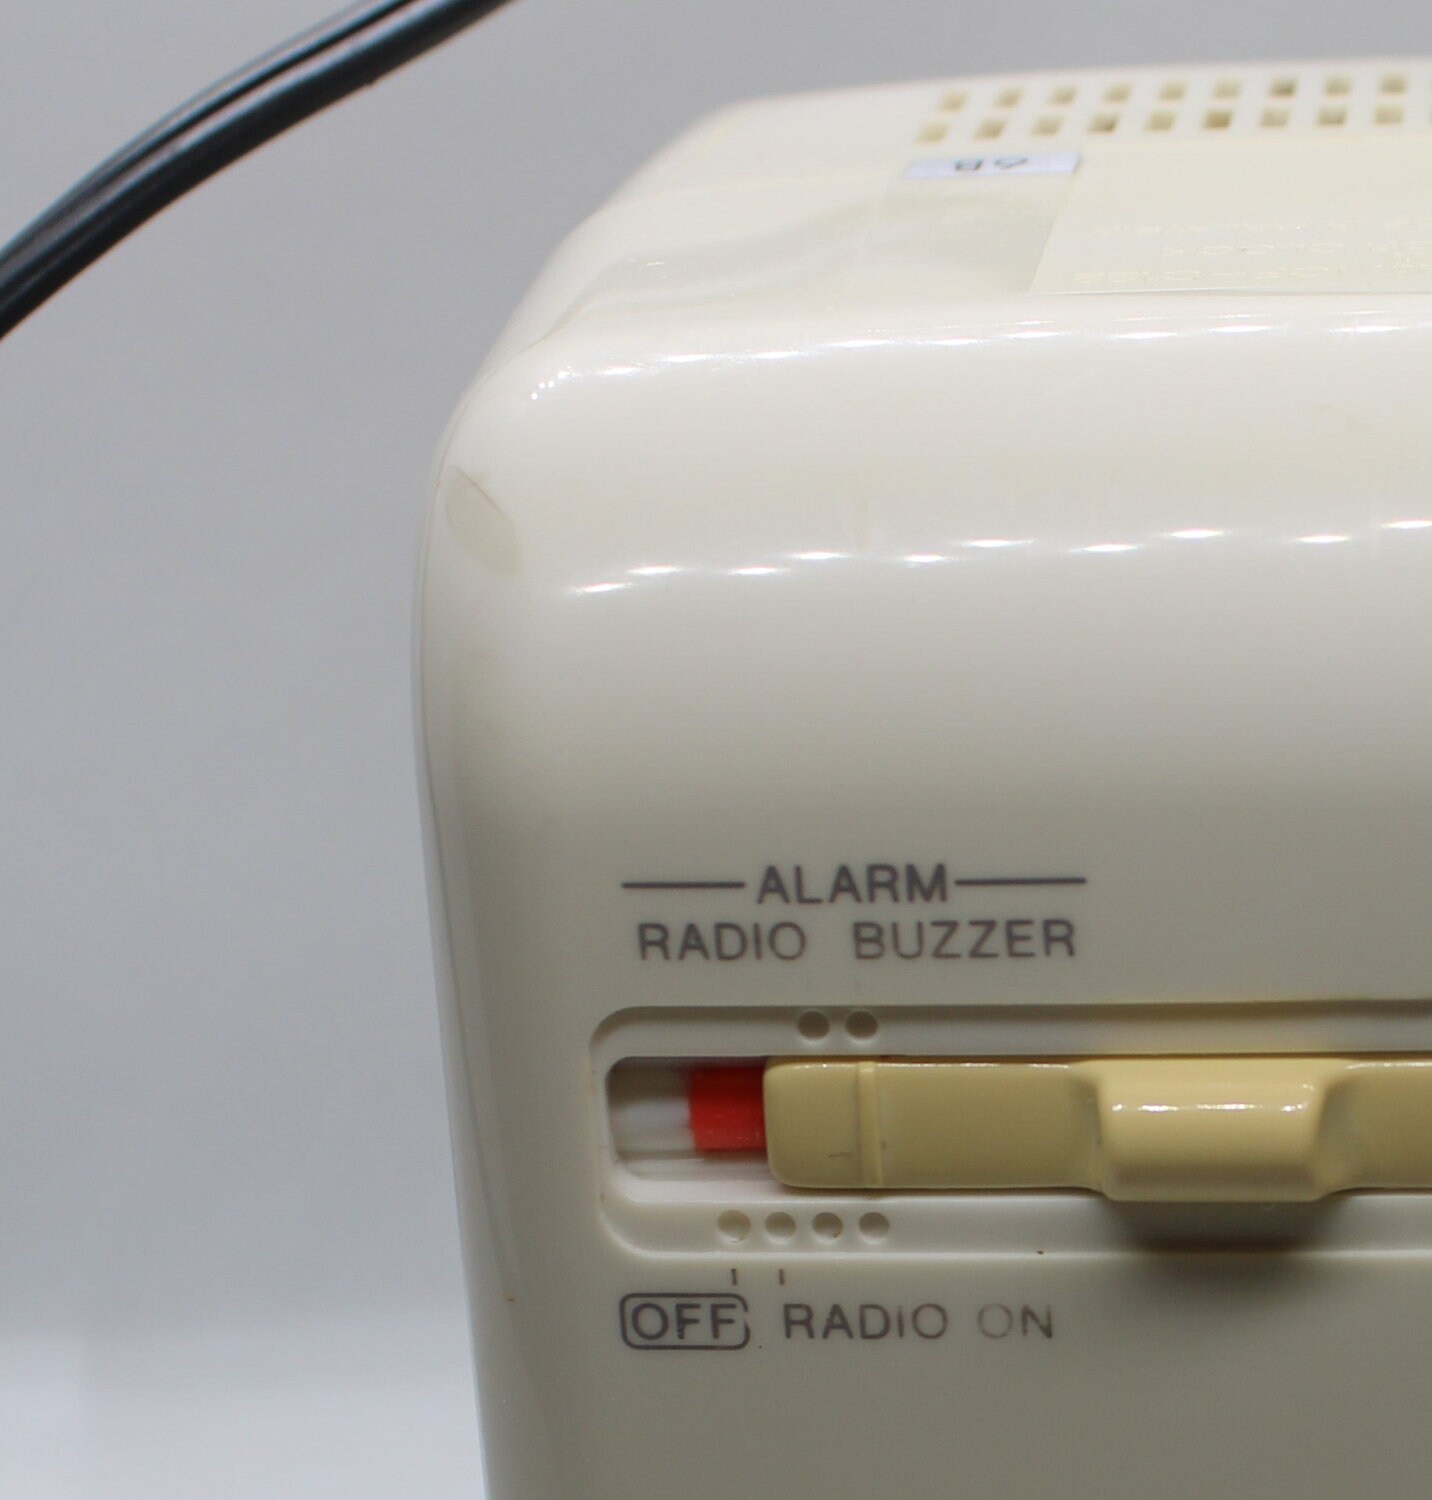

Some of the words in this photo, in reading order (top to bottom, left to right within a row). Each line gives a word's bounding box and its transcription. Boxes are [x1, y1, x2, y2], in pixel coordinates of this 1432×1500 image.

[756, 863, 949, 905] ALARM
[637, 922, 807, 961] RADIO
[852, 918, 1078, 960] BUZZER
[631, 1303, 739, 1341] OFF
[783, 1303, 949, 1340] RADIO
[977, 1302, 1055, 1339] ON
